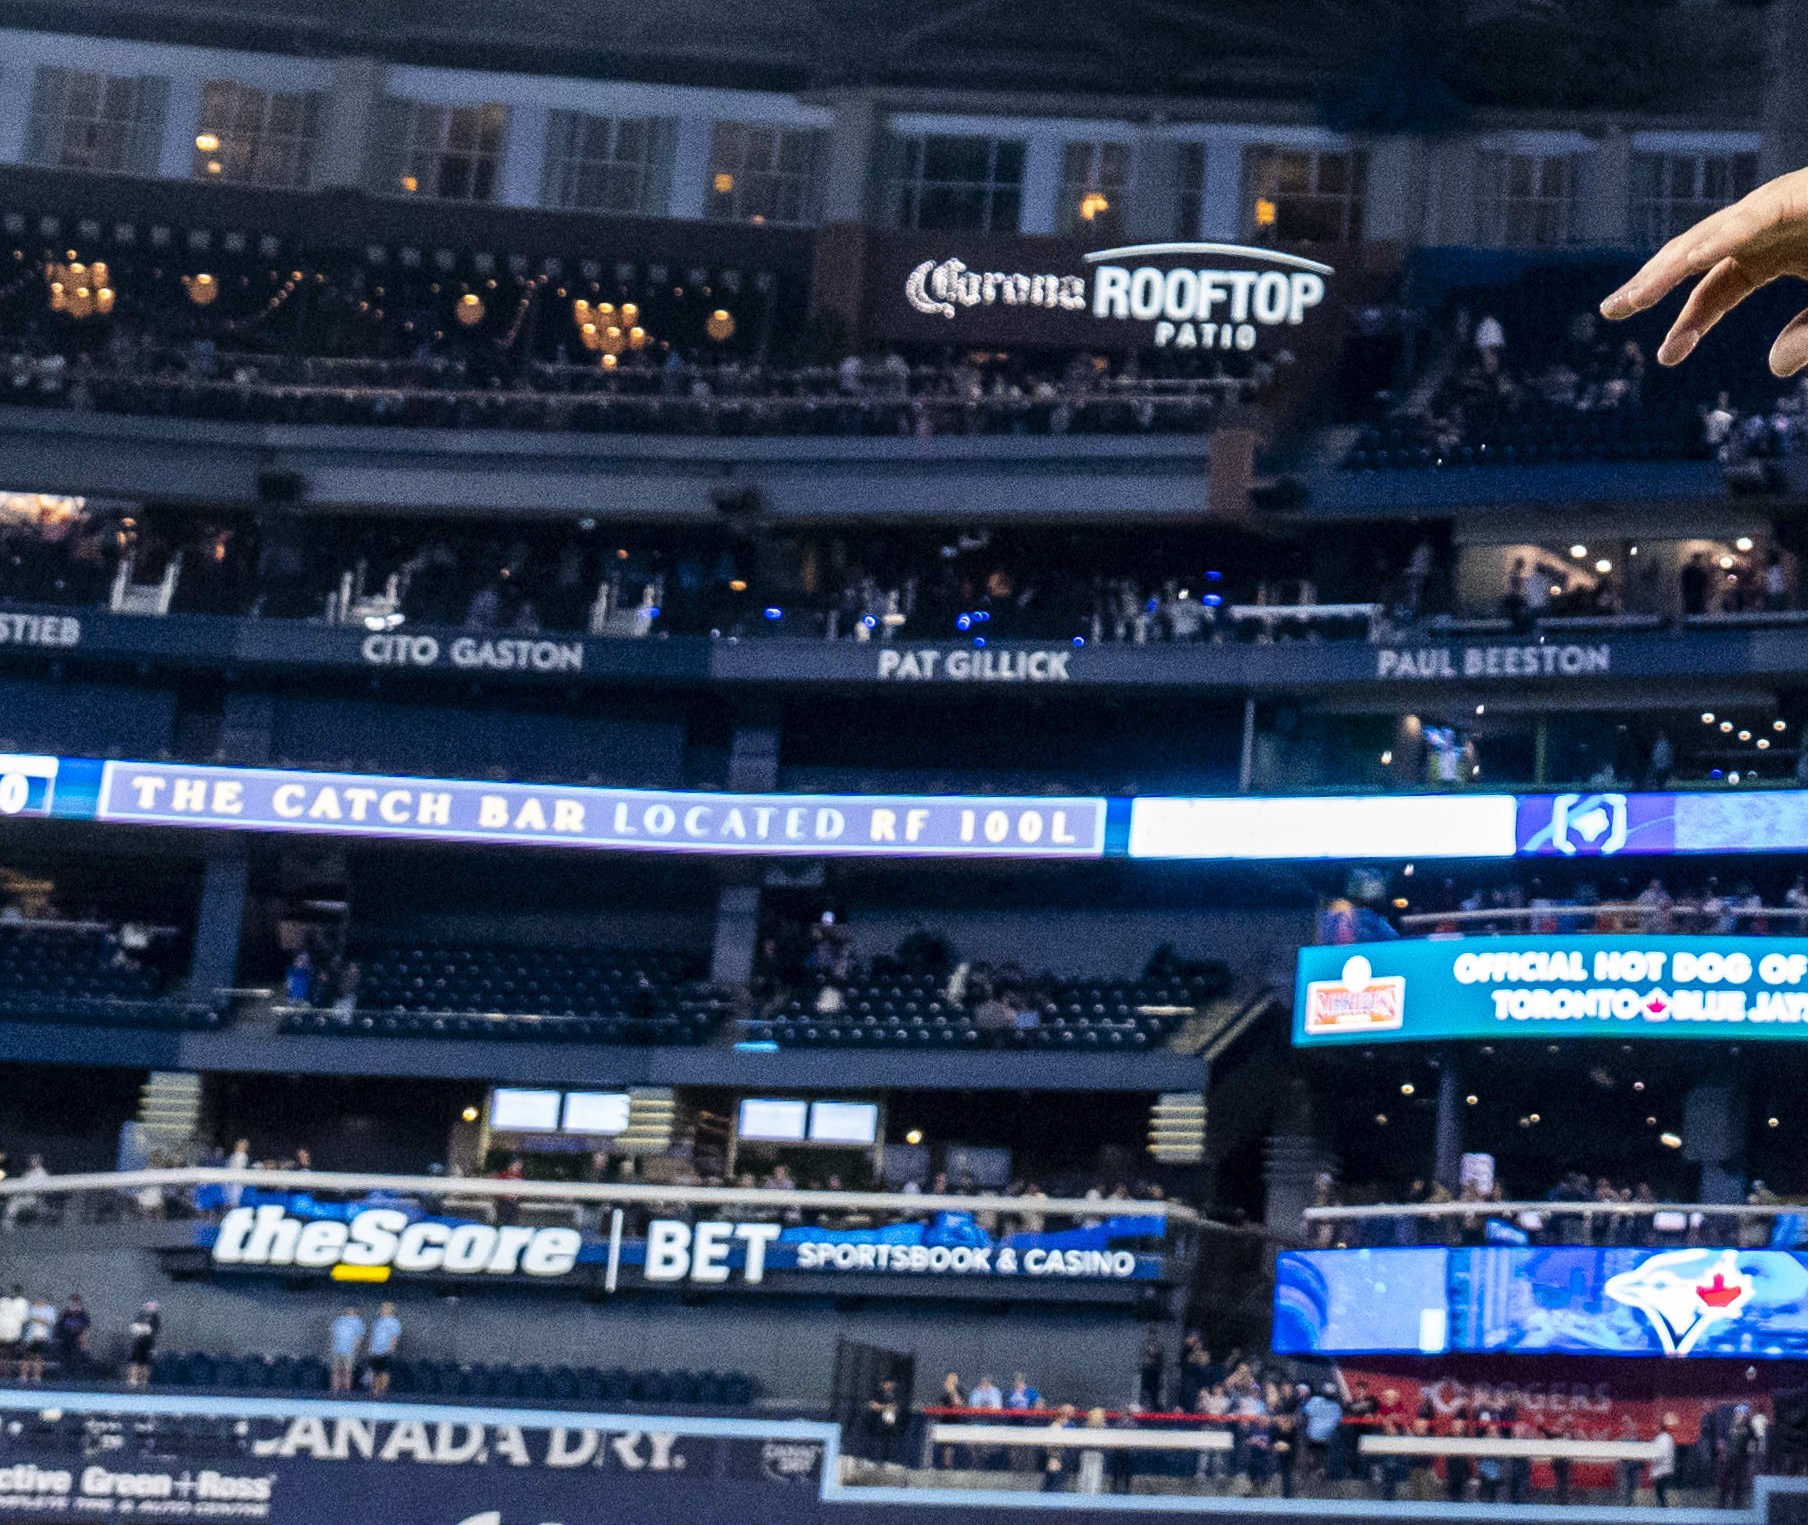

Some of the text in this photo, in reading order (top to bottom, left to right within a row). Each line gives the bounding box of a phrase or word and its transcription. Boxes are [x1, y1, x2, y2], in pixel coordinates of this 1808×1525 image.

[906, 257, 1324, 325] Corona ROOFTOP
[1155, 321, 1257, 351] PATIO
[363, 634, 583, 671] CITO GASTON
[878, 648, 1071, 681] PAT GILLICK
[1377, 644, 1610, 678] PAUL BEESTON
[131, 775, 244, 816] THE
[272, 782, 453, 827] CATCH
[478, 796, 587, 834] BAR
[613, 801, 846, 841] LOCATED
[868, 808, 930, 843] RF
[1453, 951, 1588, 984] OFFICIAL
[1594, 950, 1667, 982] HOT
[1672, 952, 1752, 984] DOG
[1758, 953, 1808, 984] OF
[1491, 988, 1640, 1020] TORONTO
[1671, 990, 1746, 1022] BLUE
[212, 1204, 1136, 1285] theScore BET SPORTSBOOK & CASINO
